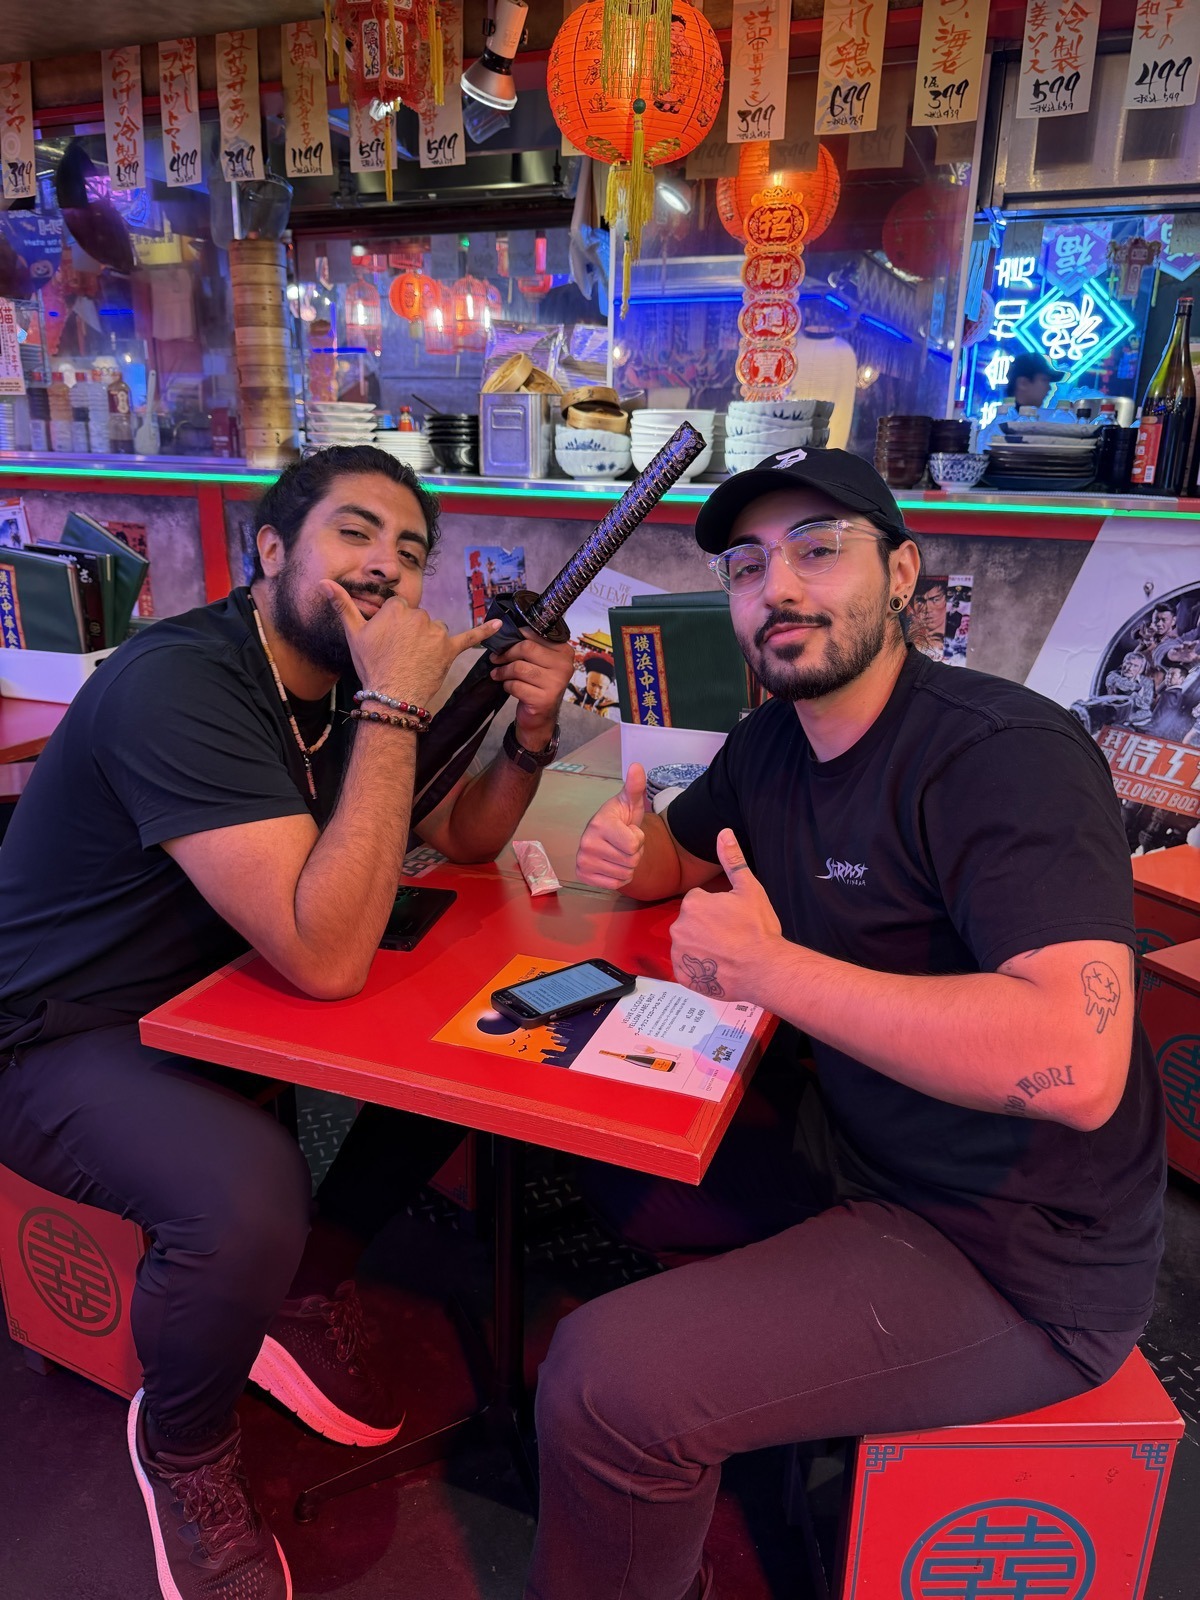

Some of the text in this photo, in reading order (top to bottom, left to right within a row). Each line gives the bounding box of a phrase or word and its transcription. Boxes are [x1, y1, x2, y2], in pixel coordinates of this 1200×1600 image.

[1030, 71, 1080, 104] 599
[1135, 56, 1192, 95] 499
[828, 82, 871, 117] 699
[928, 79, 969, 109] 399
[737, 104, 775, 133] 399
[224, 145, 255, 174] 399
[291, 143, 323, 168] 1199
[427, 133, 458, 160] 599
[8, 161, 32, 187] 399
[116, 161, 139, 186] 699
[169, 149, 197, 177] 499
[634, 635, 660, 727] 横浜中華食
